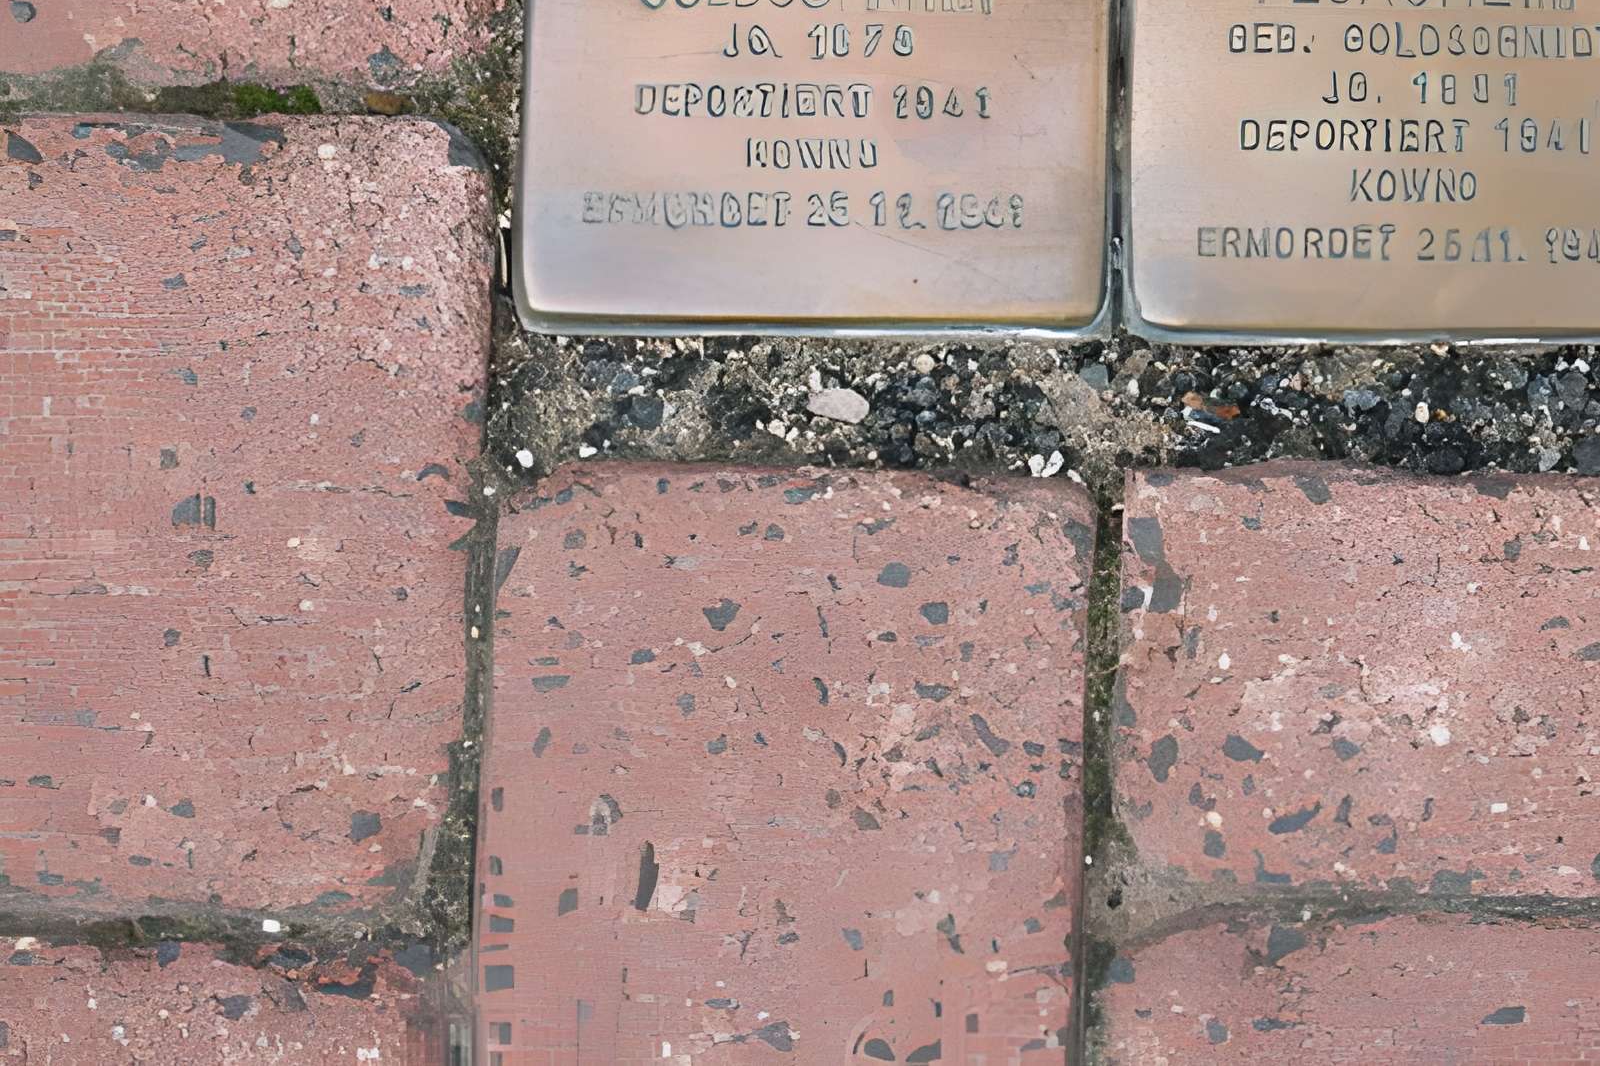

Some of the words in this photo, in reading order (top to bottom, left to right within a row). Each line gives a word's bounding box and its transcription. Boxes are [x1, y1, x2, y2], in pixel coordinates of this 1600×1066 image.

[1240, 118, 1469, 153] DEPORTIERT
[1350, 168, 1477, 202] KOWNO
[1198, 225, 1396, 260] ERMORDET
